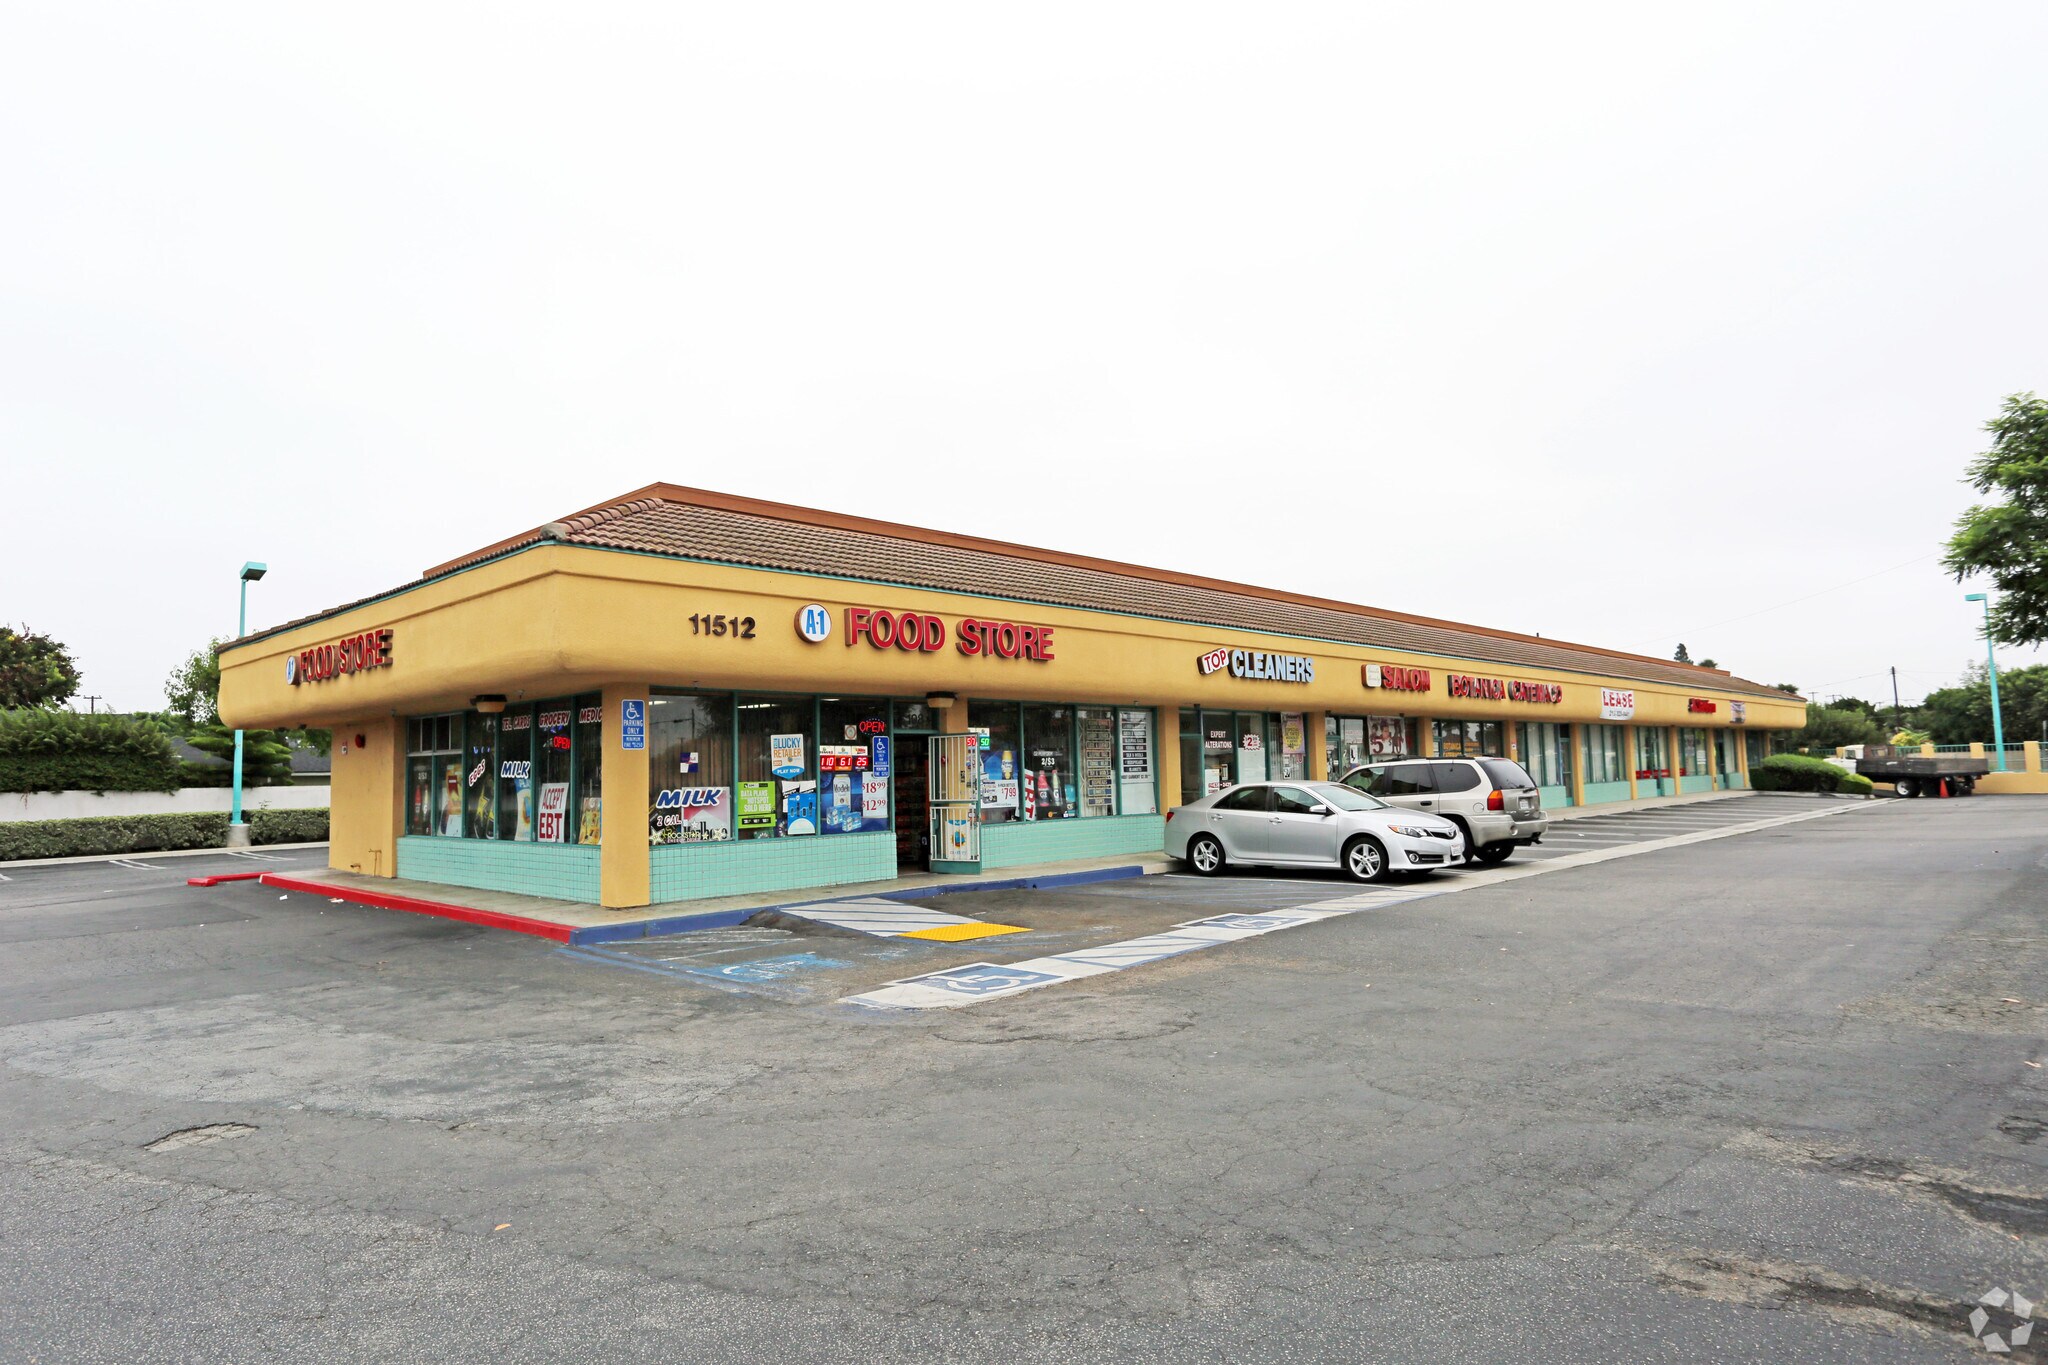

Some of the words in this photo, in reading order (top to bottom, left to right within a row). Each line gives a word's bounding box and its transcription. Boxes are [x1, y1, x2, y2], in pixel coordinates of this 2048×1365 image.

[689, 613, 756, 639] 11512
[847, 608, 945, 652] FOOD
[959, 619, 1054, 661] STORE
[301, 645, 334, 681] FOOD
[339, 629, 386, 674] STORE
[1204, 649, 1227, 672] TOP
[1231, 649, 1315, 683] CLEANERS
[1382, 666, 1431, 692] SALON
[1450, 675, 1507, 700] BOTANICA
[1511, 680, 1563, 704] CATEMACO
[1603, 690, 1633, 708] LEASE
[539, 711, 570, 728] GROCERY
[623, 719, 643, 727] PARKING
[627, 727, 640, 735] ONLY
[859, 720, 885, 733] OPEN
[1210, 730, 1226, 738] EXPERT
[553, 736, 571, 749] OPEN
[777, 737, 801, 749] LUCKY
[980, 737, 990, 746] 50
[1205, 741, 1232, 749] ALTERATIONS
[773, 748, 802, 758] RETAILER
[821, 757, 834, 767] 110
[840, 757, 852, 766] 61
[856, 757, 867, 766] 25
[469, 758, 486, 787] EGGS
[501, 761, 531, 779] MILK
[541, 787, 565, 810] ACCEPT
[656, 788, 721, 809] MILK
[753, 789, 768, 797] PLANS
[744, 804, 757, 812] SOLD
[759, 803, 772, 812] HERE
[539, 813, 562, 839] EBT
[656, 815, 663, 827] 2
